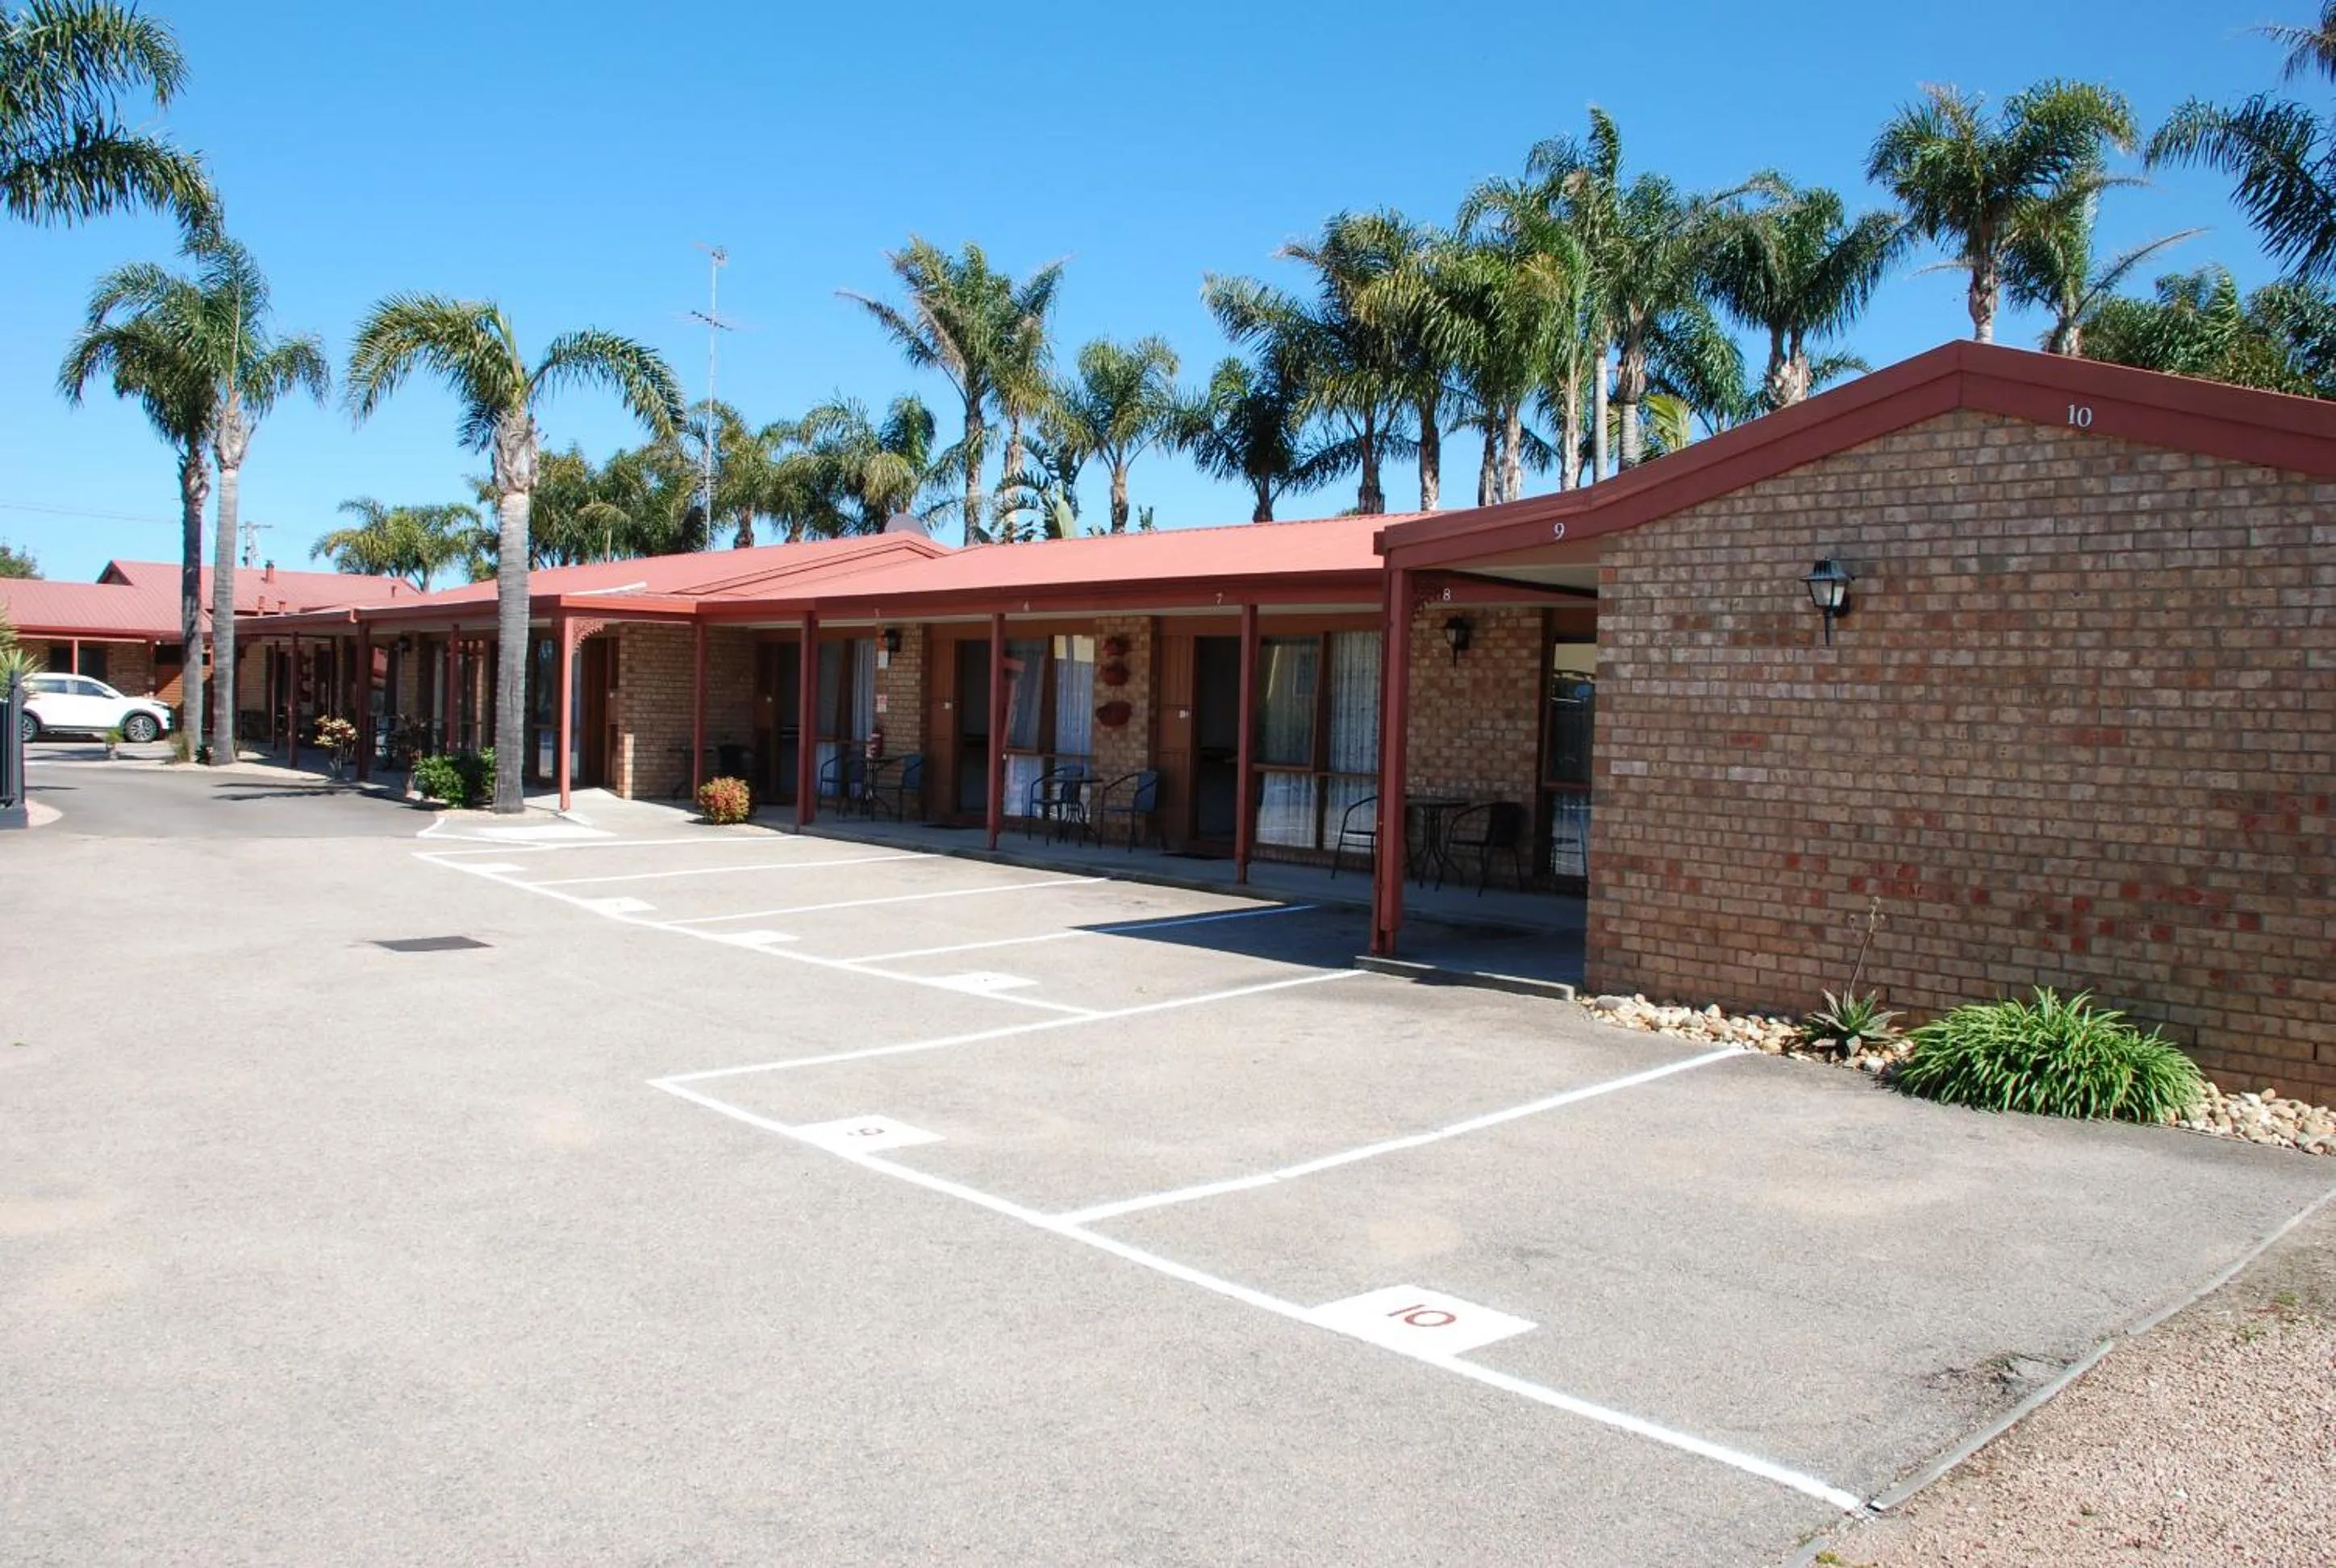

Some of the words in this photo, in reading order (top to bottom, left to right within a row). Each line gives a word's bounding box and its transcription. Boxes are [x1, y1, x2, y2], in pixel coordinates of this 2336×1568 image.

[2067, 404, 2092, 427] 10
[1554, 523, 1565, 540] 9
[1443, 588, 1451, 601] 8
[1386, 1303, 1457, 1328] 10
